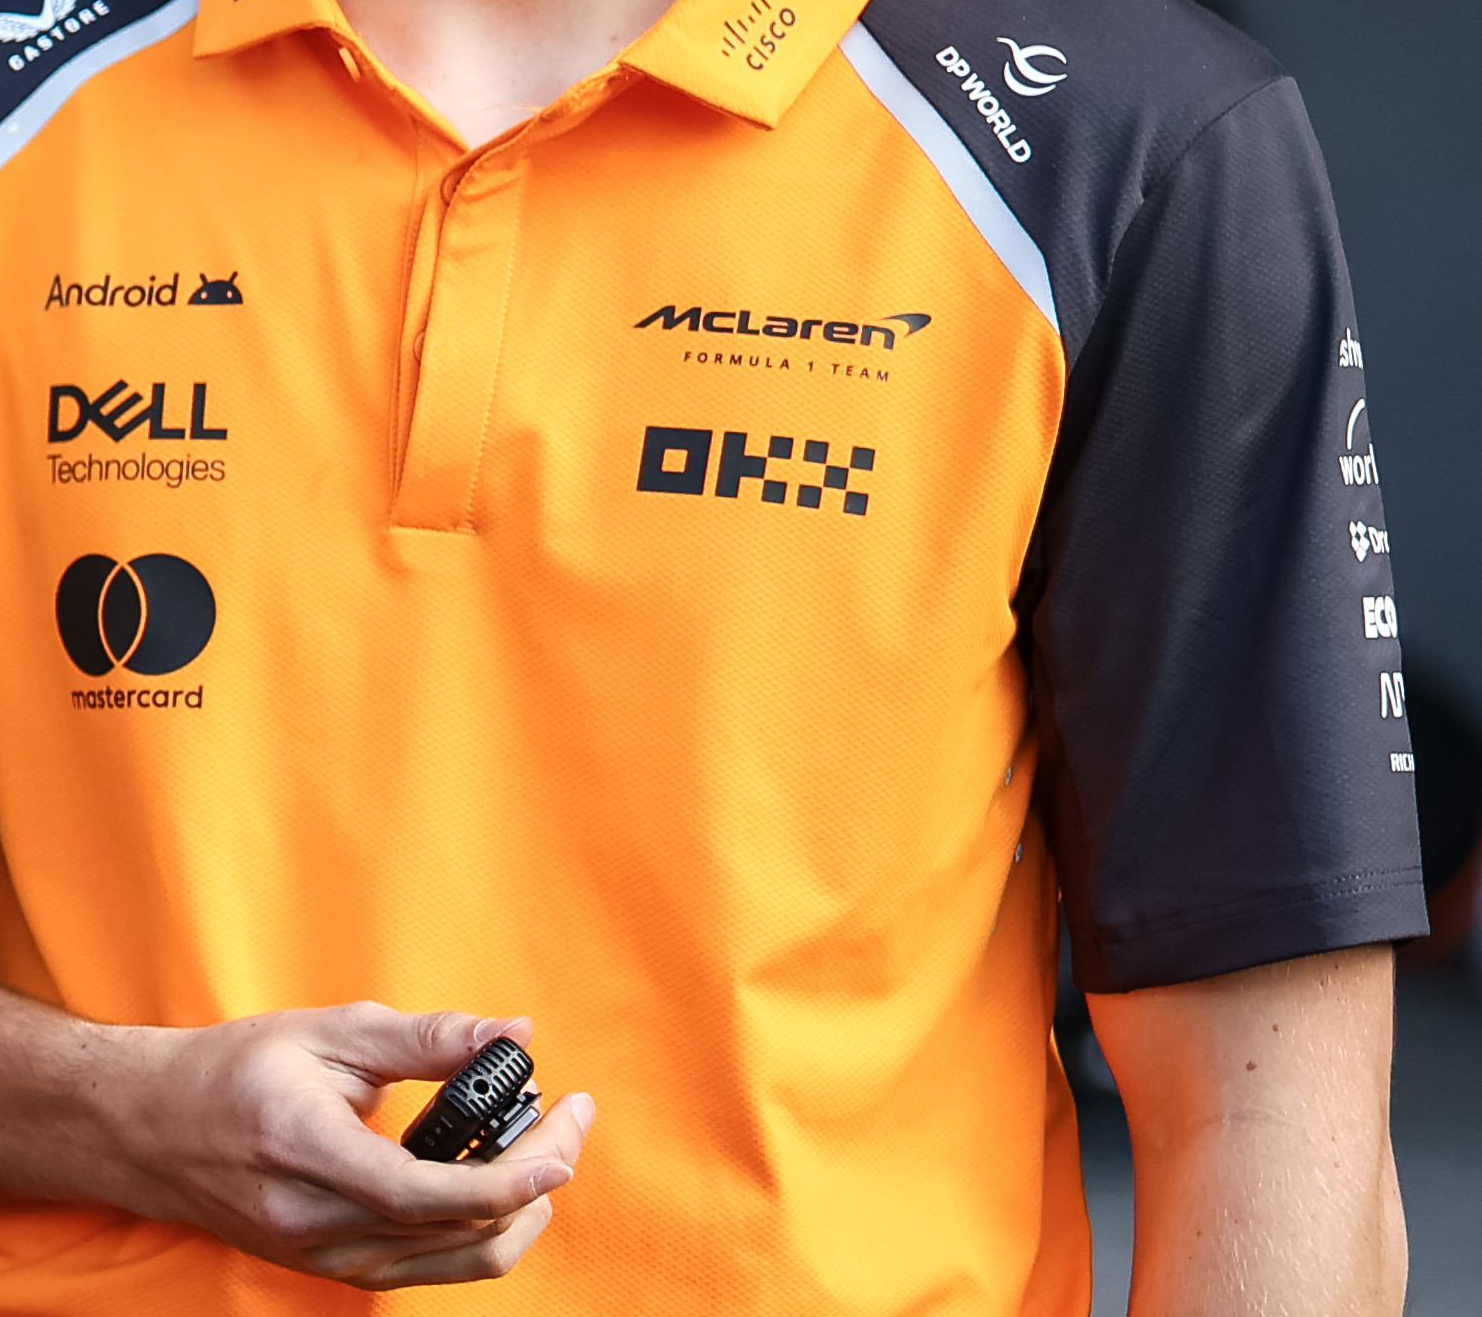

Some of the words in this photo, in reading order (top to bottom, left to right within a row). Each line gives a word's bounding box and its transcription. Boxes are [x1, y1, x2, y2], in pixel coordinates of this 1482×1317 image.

[8, 0, 110, 71] CASTORE
[935, 45, 970, 77] DP
[961, 73, 1032, 163] WORLD
[45, 272, 179, 311] Android
[634, 305, 895, 350] McLaren
[684, 351, 790, 370] FORMULA
[832, 364, 890, 382] TEAM
[48, 380, 228, 443] DELL
[47, 453, 225, 488] Technologies
[72, 686, 203, 710] mastercard
